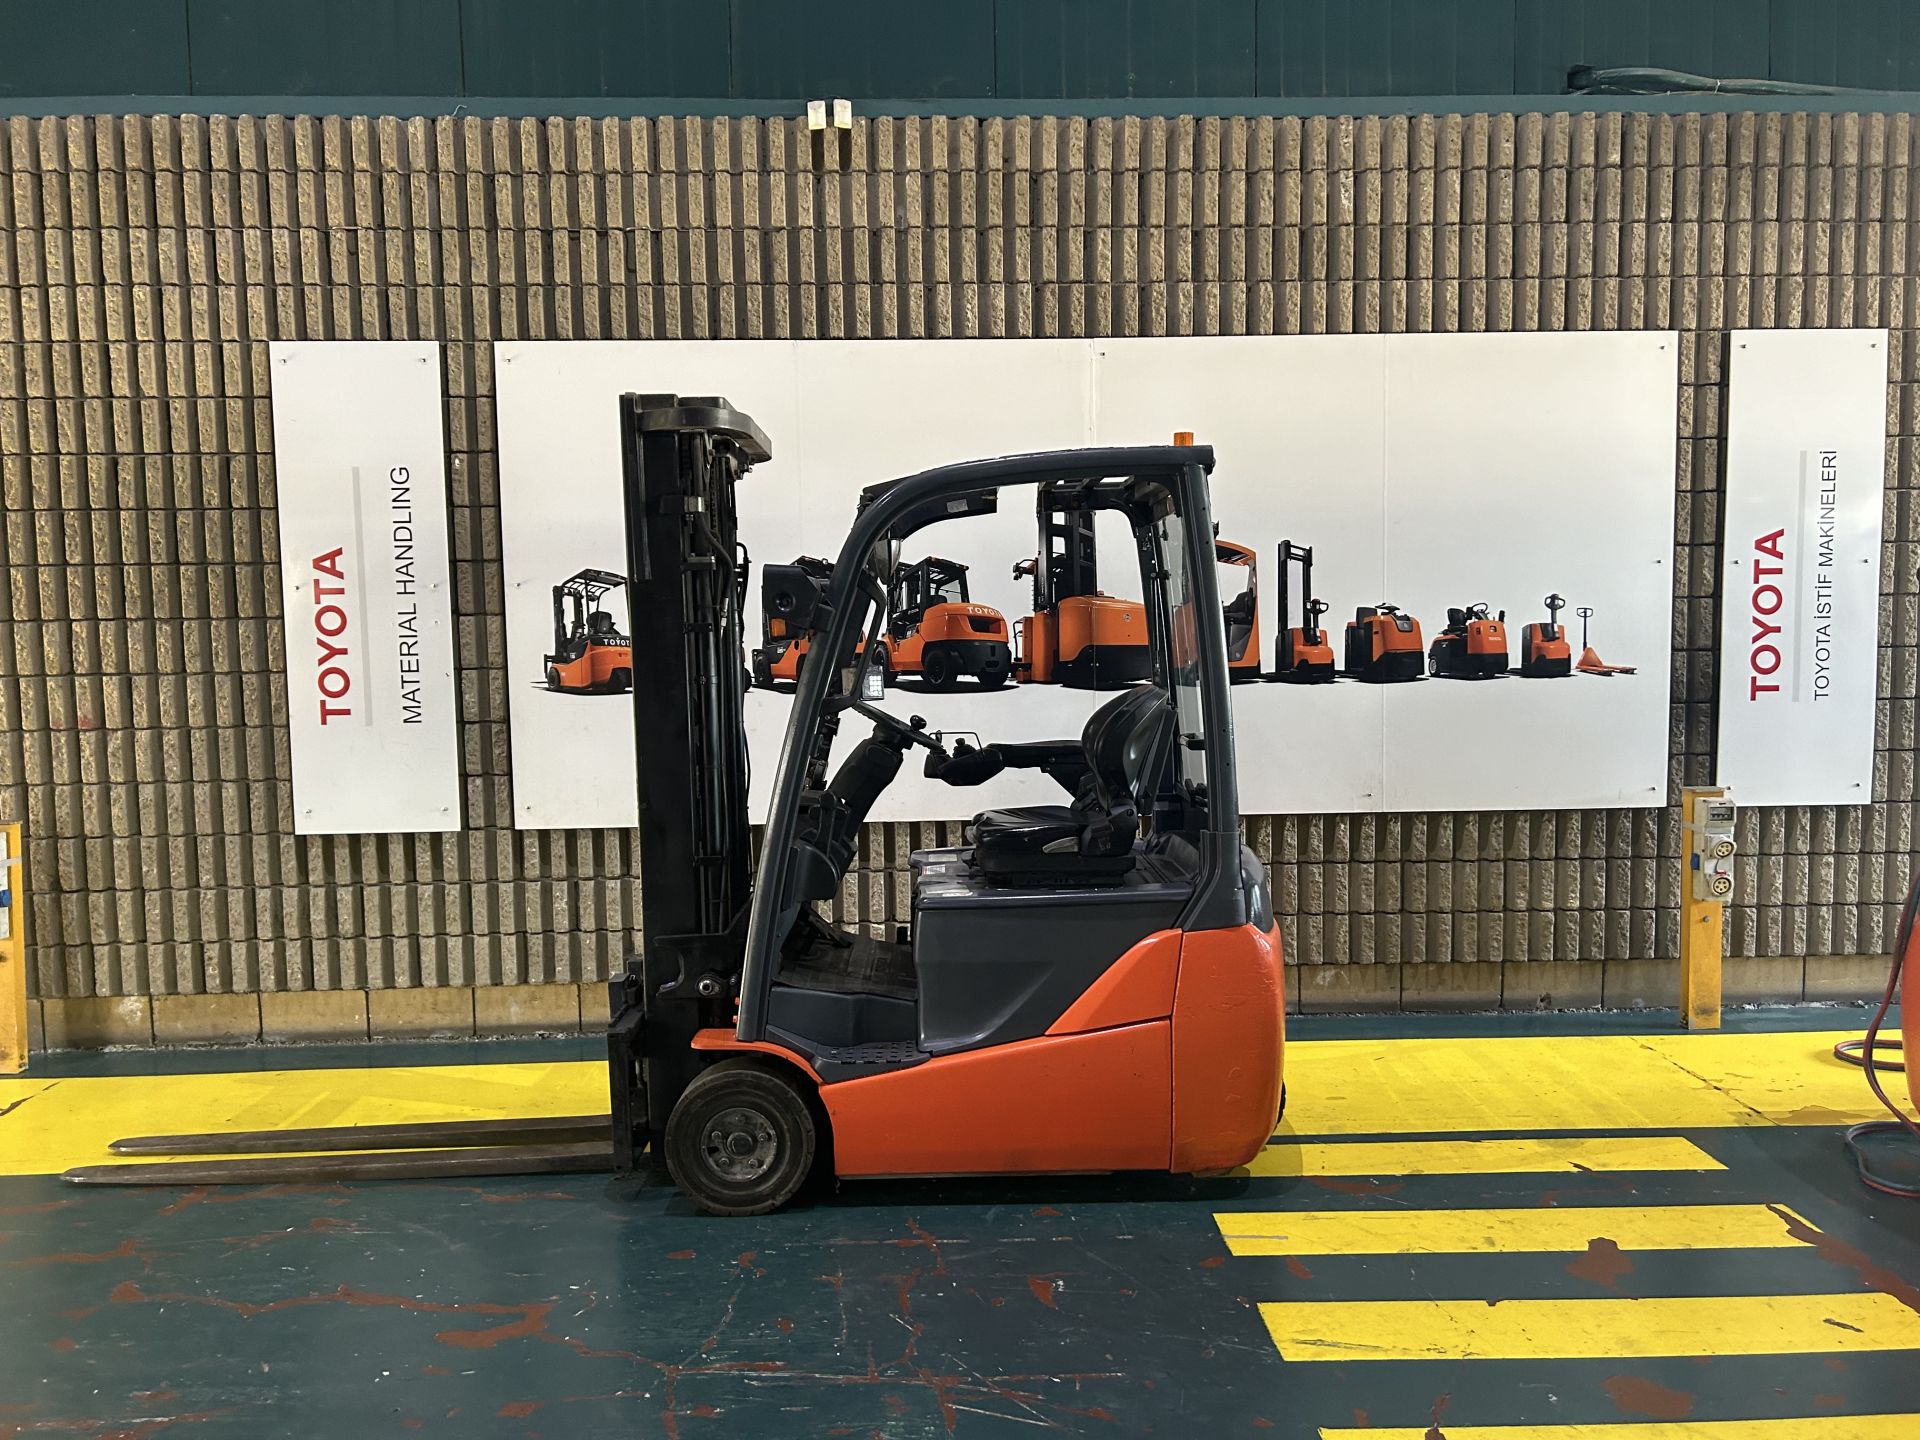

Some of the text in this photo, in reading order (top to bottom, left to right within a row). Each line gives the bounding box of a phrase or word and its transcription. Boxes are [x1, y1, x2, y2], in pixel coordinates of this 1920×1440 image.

[312, 547, 351, 726] TOYOTA
[389, 467, 422, 724] MATERIAL HANDLING
[603, 638, 630, 646] TOYOT
[1750, 529, 1785, 701] TOYOTA
[1814, 450, 1837, 702] TOYOTA İSTİF MAKİNELERİ
